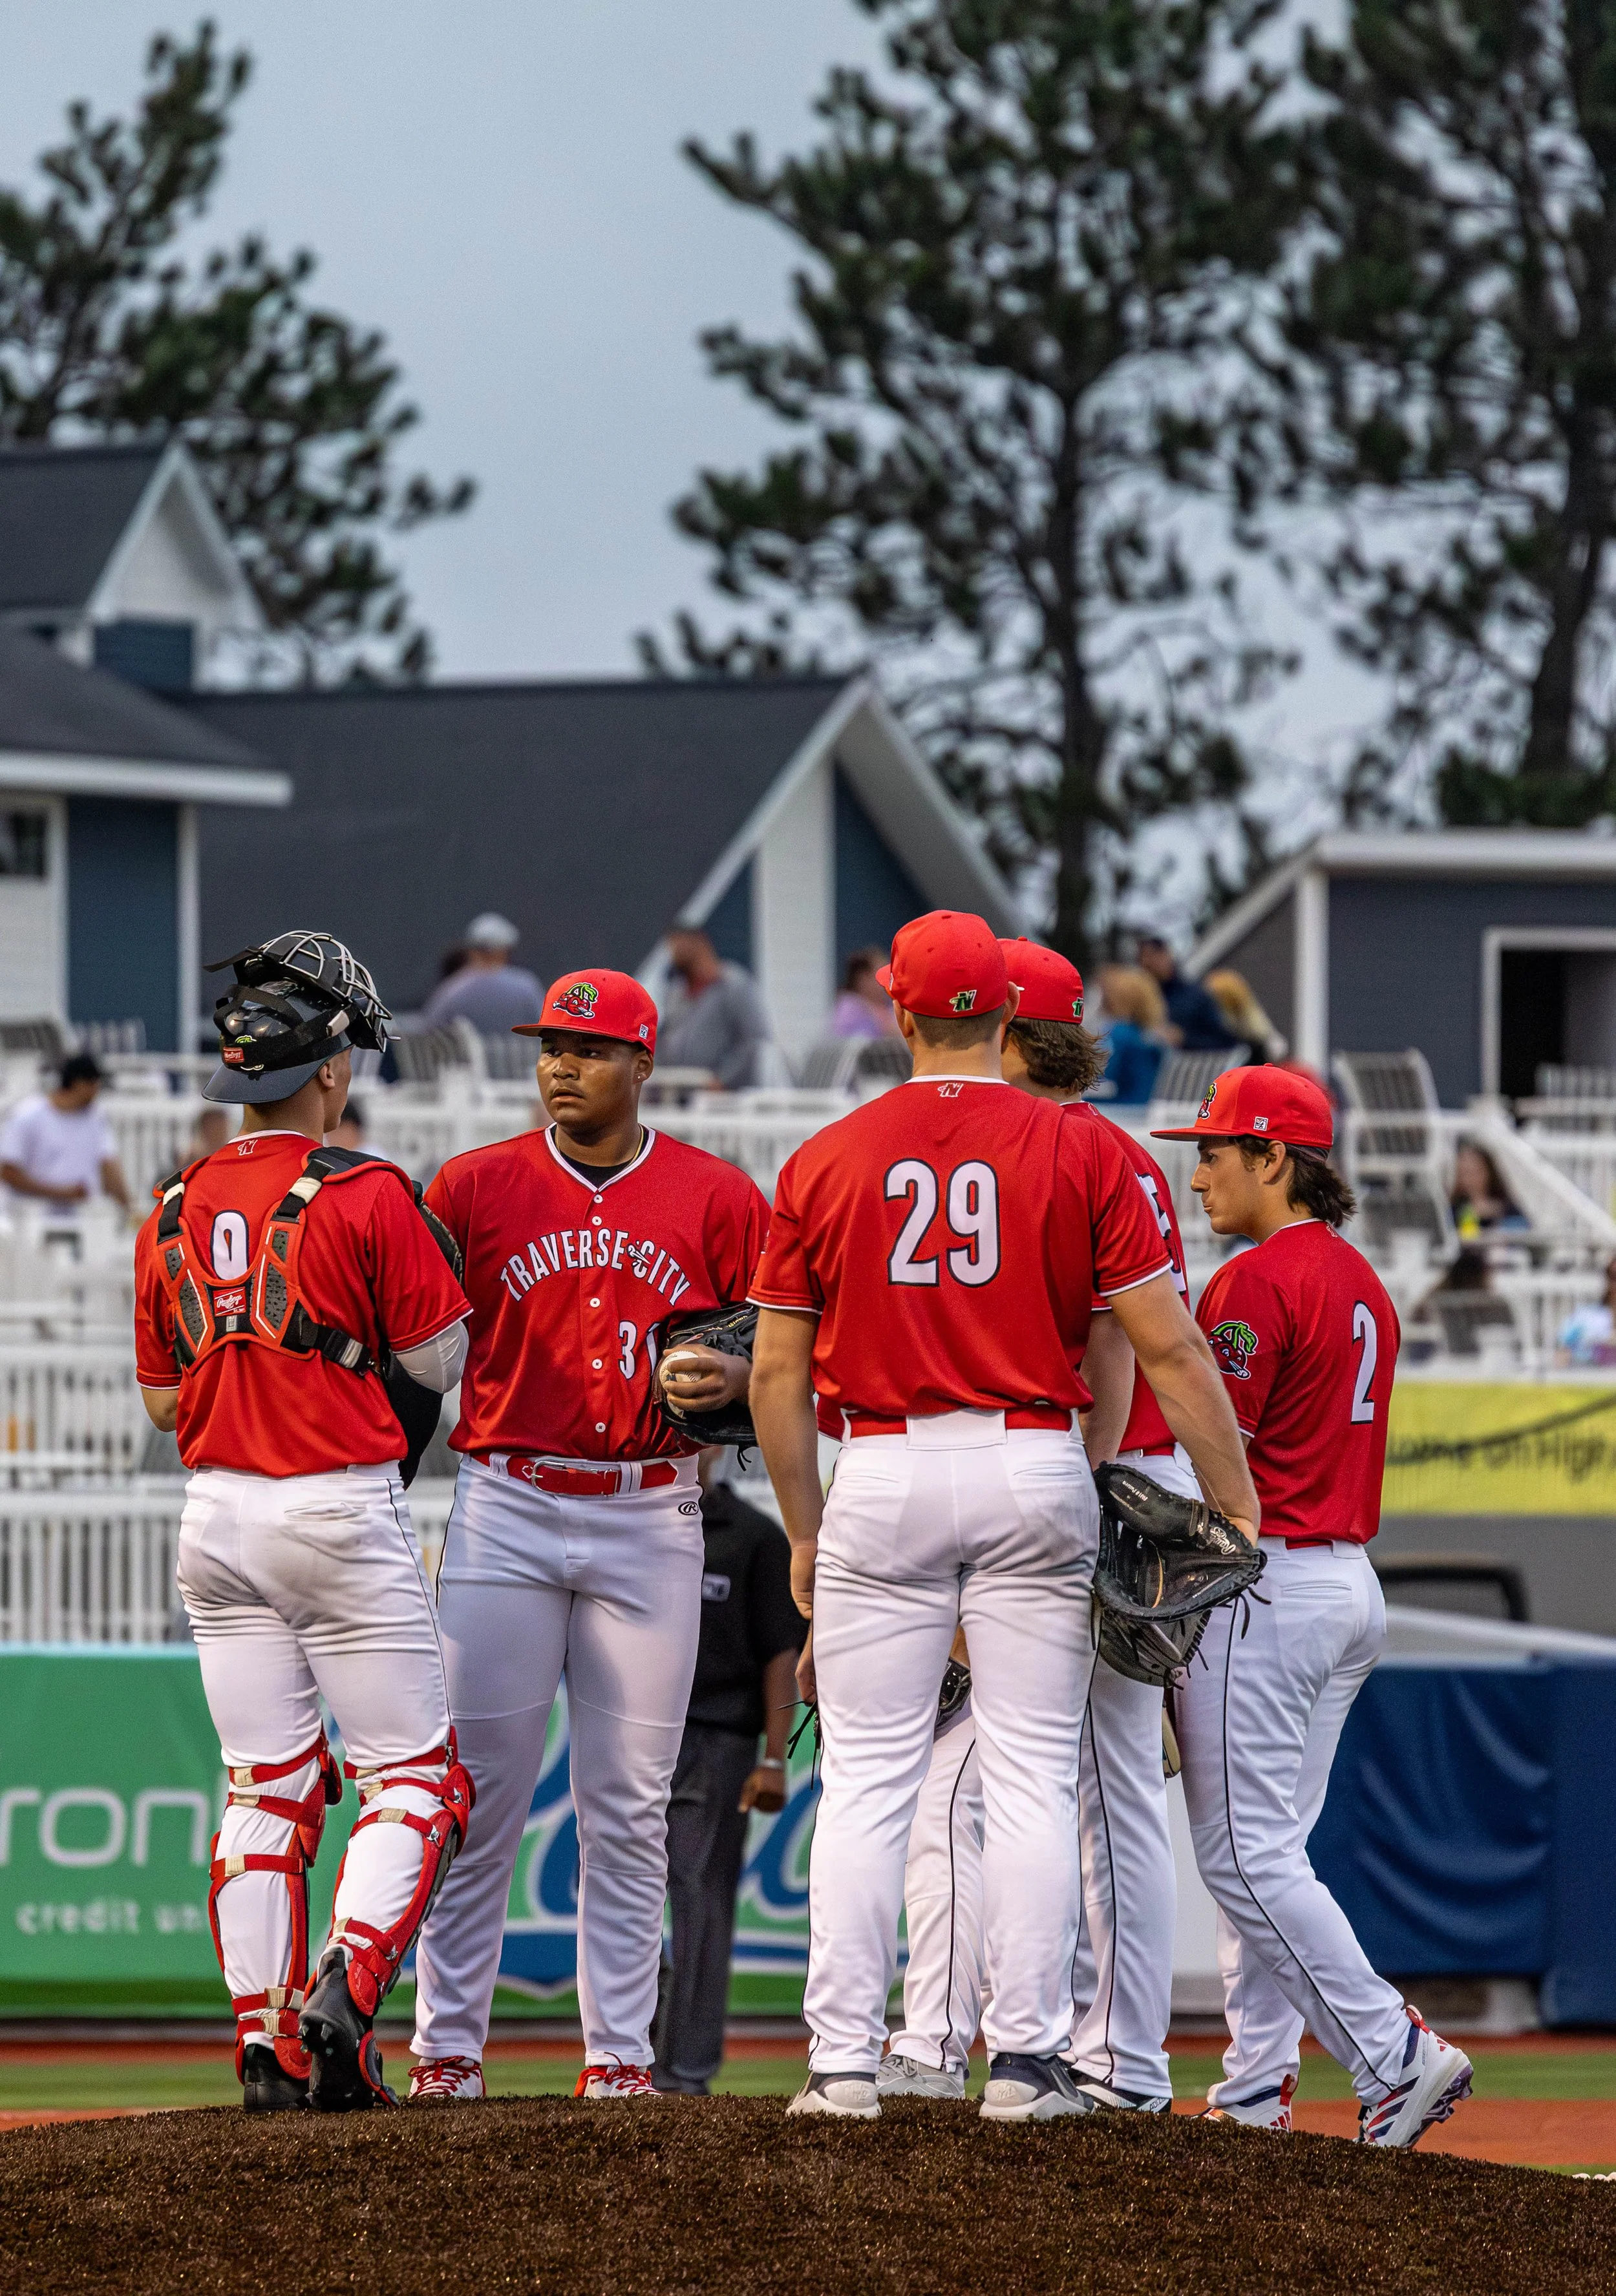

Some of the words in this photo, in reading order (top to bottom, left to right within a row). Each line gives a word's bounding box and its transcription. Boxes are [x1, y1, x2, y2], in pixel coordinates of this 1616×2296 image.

[210, 1210, 250, 1281] 0
[884, 1157, 1003, 1288] 29
[499, 1228, 629, 1302] TRAVERSE
[631, 1239, 692, 1306] CITY
[1350, 1300, 1378, 1424] 2
[0, 1782, 228, 1868] ron
[16, 1898, 140, 1936] credit
